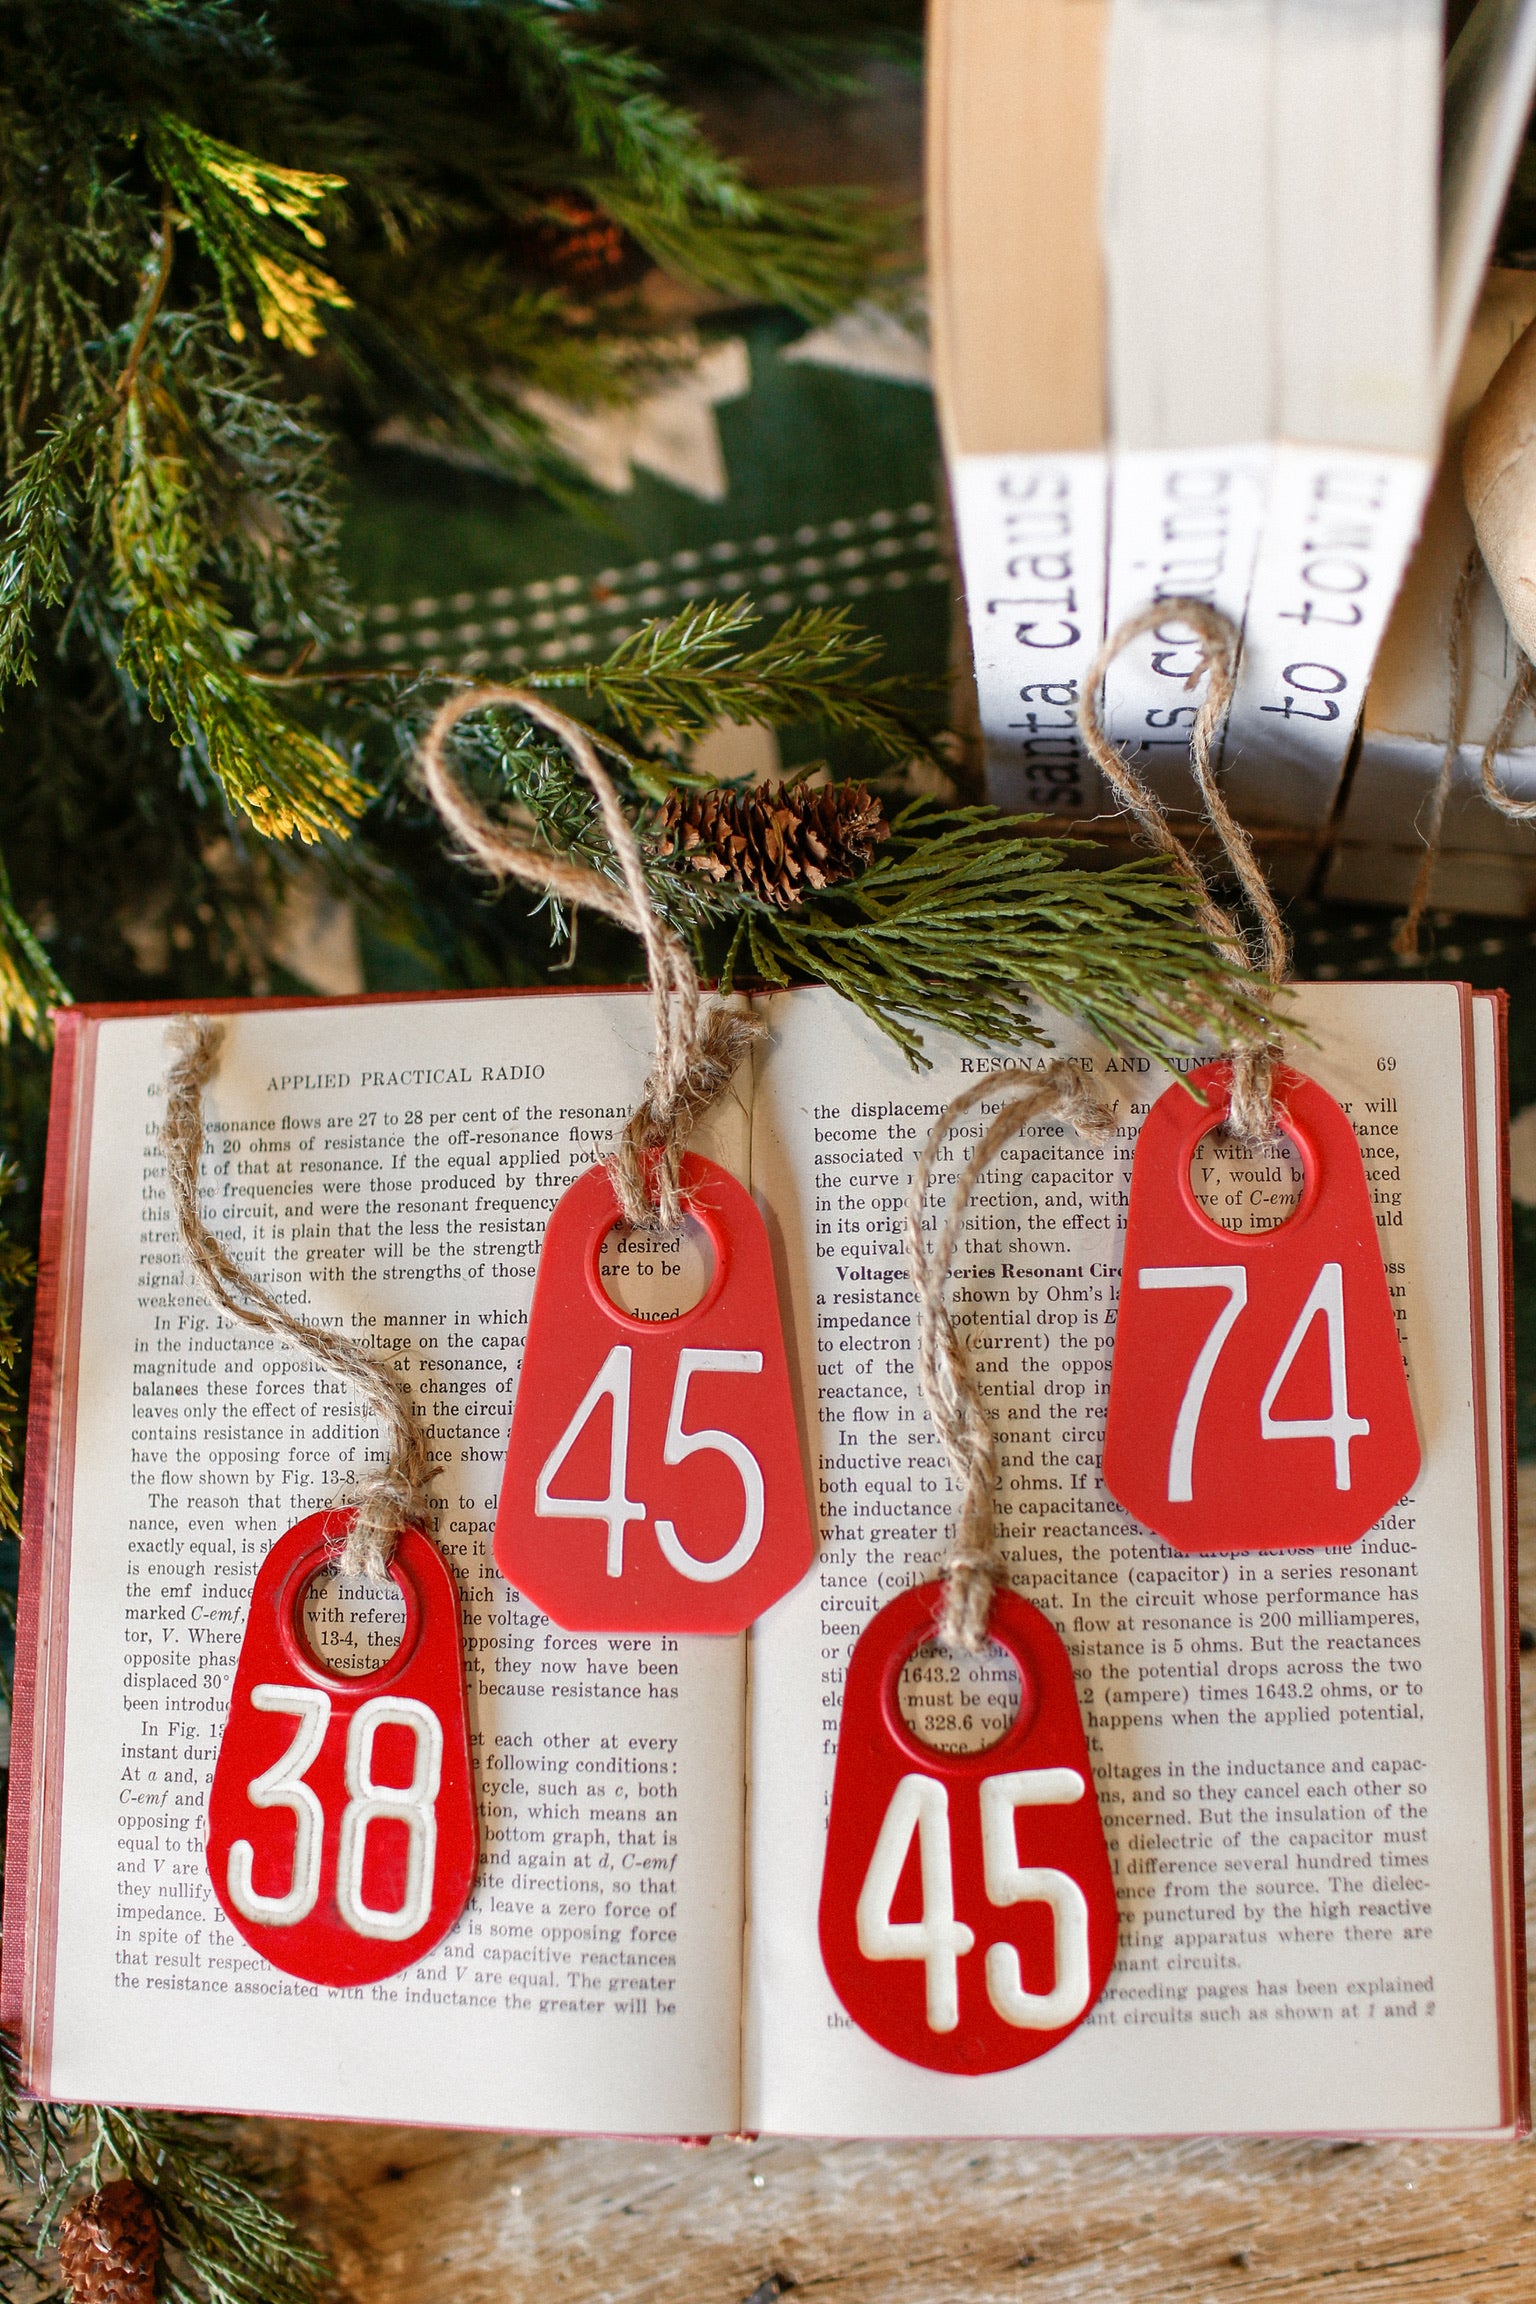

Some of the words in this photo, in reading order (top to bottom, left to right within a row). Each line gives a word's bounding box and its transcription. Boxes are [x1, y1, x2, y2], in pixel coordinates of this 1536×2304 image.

[987, 472, 1081, 648] claus
[1259, 663, 1348, 721] to
[1008, 679, 1083, 808] santa
[1104, 1056, 1150, 1073] AND
[1377, 1057, 1396, 1071] 69
[267, 1074, 350, 1091] APPLIED
[361, 1068, 471, 1086] PRACTICAL
[481, 1065, 544, 1081] RADIO
[281, 1115, 321, 1130] flows
[327, 1117, 352, 1128] are
[359, 1112, 377, 1127] 27
[384, 1113, 398, 1126] to
[404, 1110, 423, 1125] 28
[429, 1113, 456, 1127] per
[462, 1108, 497, 1123] cent
[502, 1106, 520, 1121] of
[526, 1105, 552, 1120] the
[559, 1104, 634, 1119] resonant
[214, 1160, 230, 1175] of
[238, 1160, 269, 1175] that
[277, 1160, 292, 1173] at
[300, 1160, 382, 1172] resonance.
[392, 1154, 407, 1169] If
[415, 1154, 439, 1168] the
[448, 1151, 494, 1170] equal
[498, 1149, 560, 1168] applied
[223, 1203, 278, 1219] circuit,
[285, 1202, 313, 1217] and
[321, 1204, 359, 1215] were
[366, 1199, 390, 1214] the
[397, 1197, 469, 1214] resonant
[475, 1196, 559, 1213] frequency
[254, 1225, 265, 1239] it
[272, 1225, 284, 1239] is
[291, 1223, 330, 1241] plain
[338, 1222, 371, 1237] that
[378, 1221, 403, 1236] the
[410, 1220, 439, 1236] less
[446, 1219, 471, 1234] the
[964, 1239, 1003, 1253] that
[1008, 1237, 1071, 1253] shown.
[309, 1266, 344, 1281] with
[351, 1266, 376, 1280] the
[383, 1264, 461, 1281] strengths
[468, 1263, 485, 1278] of
[492, 1263, 535, 1277] those
[836, 1266, 911, 1282] Voltages
[1001, 1262, 1084, 1279] Resonant
[951, 1309, 1032, 1331] potential
[1037, 1309, 1078, 1328] drop
[1084, 1309, 1098, 1324] is
[133, 1381, 198, 1396] balances
[207, 1380, 247, 1395] these
[256, 1380, 305, 1395] forces
[313, 1379, 347, 1394] that
[1138, 1262, 1370, 1503] 74
[132, 1426, 197, 1440] contains
[203, 1426, 283, 1440] resistance
[290, 1425, 305, 1439] in
[312, 1424, 379, 1439] addition
[534, 1345, 765, 1583] 45
[131, 1470, 155, 1485] the
[161, 1470, 193, 1485] flow
[199, 1470, 249, 1484] shown
[256, 1470, 275, 1487] by
[281, 1470, 314, 1487] Fig.
[321, 1470, 361, 1486] 13-8.
[148, 1493, 178, 1508] The
[187, 1496, 239, 1508] reason
[248, 1494, 281, 1508] that
[290, 1494, 333, 1508] there
[129, 1520, 178, 1533] nance,
[188, 1520, 224, 1530] even
[234, 1516, 277, 1531] when
[1012, 1570, 1118, 1588] capacitance
[1129, 1566, 1228, 1586] (capacitor)
[1239, 1570, 1256, 1581] in
[1264, 1569, 1274, 1580] a
[1281, 1568, 1333, 1580] series
[1340, 1562, 1418, 1578] resonant
[1072, 1592, 1091, 1608] In
[1100, 1592, 1127, 1607] the
[1136, 1590, 1196, 1607] circuit
[1203, 1589, 1258, 1605] whose
[1266, 1587, 1382, 1607] performance
[1387, 1585, 1419, 1601] has
[125, 1605, 185, 1620] marked
[191, 1606, 248, 1624] C-emf,
[1074, 1616, 1110, 1632] flow
[1117, 1616, 1135, 1631] at
[1142, 1617, 1232, 1631] resonance
[1239, 1612, 1253, 1628] is
[1260, 1612, 1291, 1627] 200
[1298, 1610, 1419, 1628] milliamperes,
[125, 1628, 152, 1645] tor,
[188, 1628, 244, 1646] Where
[494, 1657, 531, 1675] they
[541, 1661, 577, 1674] now
[586, 1658, 629, 1674] have
[637, 1659, 679, 1675] been
[123, 1673, 197, 1691] displaced
[479, 1680, 545, 1697] because
[551, 1682, 641, 1698] resistance
[648, 1683, 679, 1699] has
[1105, 1686, 1189, 1706] (ampere)
[1199, 1685, 1248, 1701] times
[1256, 1683, 1313, 1699] 1643.2
[1321, 1682, 1372, 1699] ohms,
[1380, 1685, 1399, 1696] or
[1406, 1681, 1423, 1695] to
[1087, 1710, 1163, 1731] happens
[1171, 1709, 1219, 1725] when
[1228, 1708, 1256, 1724] the
[1265, 1706, 1330, 1726] applied
[1339, 1703, 1423, 1724] potential,
[495, 1731, 533, 1747] each
[544, 1732, 590, 1748] other
[600, 1735, 619, 1749] at
[629, 1738, 678, 1753] every
[483, 1779, 529, 1799] cycle,
[538, 1780, 577, 1796] such
[587, 1785, 605, 1796] as
[638, 1782, 677, 1798] both
[227, 1684, 444, 1942] 38
[486, 1824, 546, 1842] bottom
[552, 1828, 610, 1848] graph,
[618, 1829, 656, 1846] that
[663, 1830, 677, 1846] is
[1128, 1832, 1212, 1851] dielectric
[1223, 1831, 1241, 1848] of
[1250, 1831, 1279, 1847] the
[1289, 1829, 1373, 1849] capacitor
[1384, 1827, 1428, 1843] must
[1164, 1881, 1209, 1898] from
[1218, 1880, 1247, 1896] the
[1256, 1882, 1319, 1896] source.
[1328, 1876, 1363, 1893] The
[1372, 1875, 1430, 1893] dielec-
[856, 1766, 1088, 2033] 45
[115, 1972, 140, 1988] the
[146, 1976, 228, 1992] resistance
[235, 1981, 321, 1997] associated
